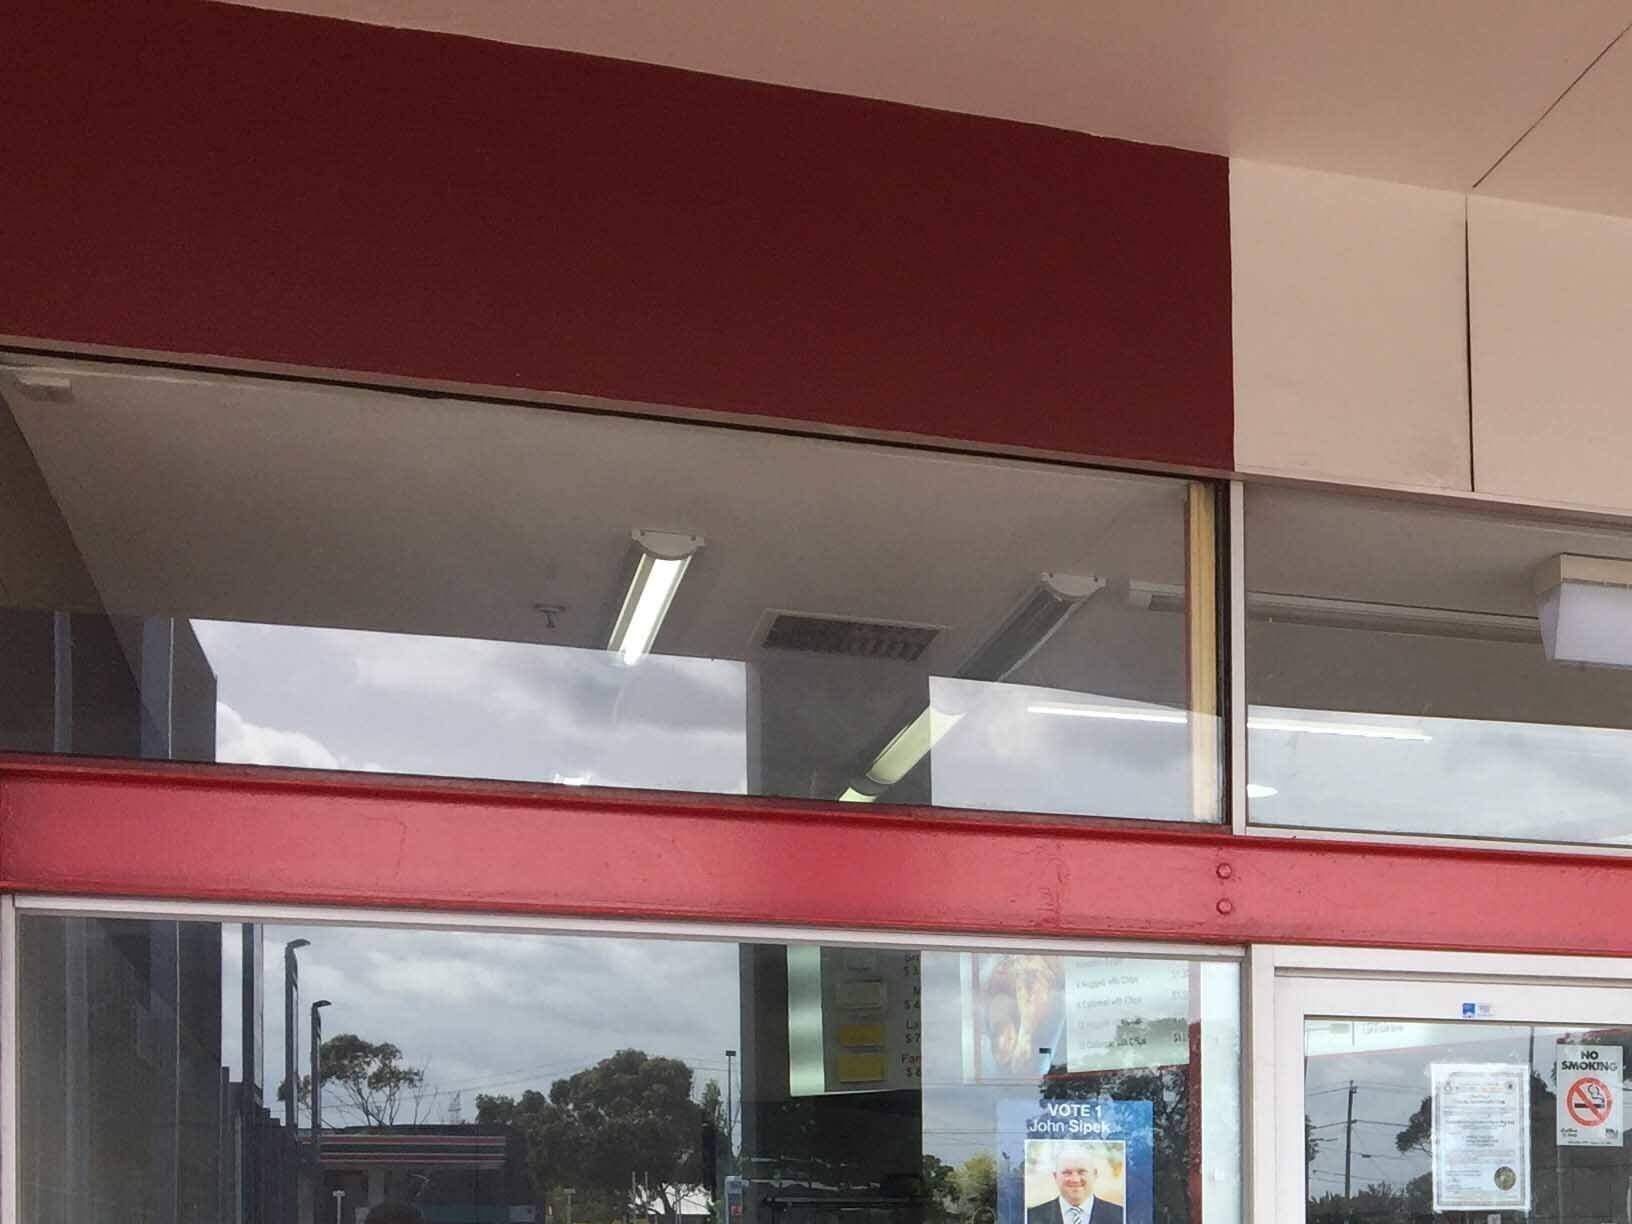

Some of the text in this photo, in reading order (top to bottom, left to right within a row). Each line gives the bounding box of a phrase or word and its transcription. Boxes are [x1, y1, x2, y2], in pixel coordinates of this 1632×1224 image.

[1580, 1050, 1599, 1060] NO
[1561, 1061, 1618, 1071] SMOKING
[1047, 1103, 1102, 1118] VOTE 1
[1029, 1120, 1065, 1133] John
